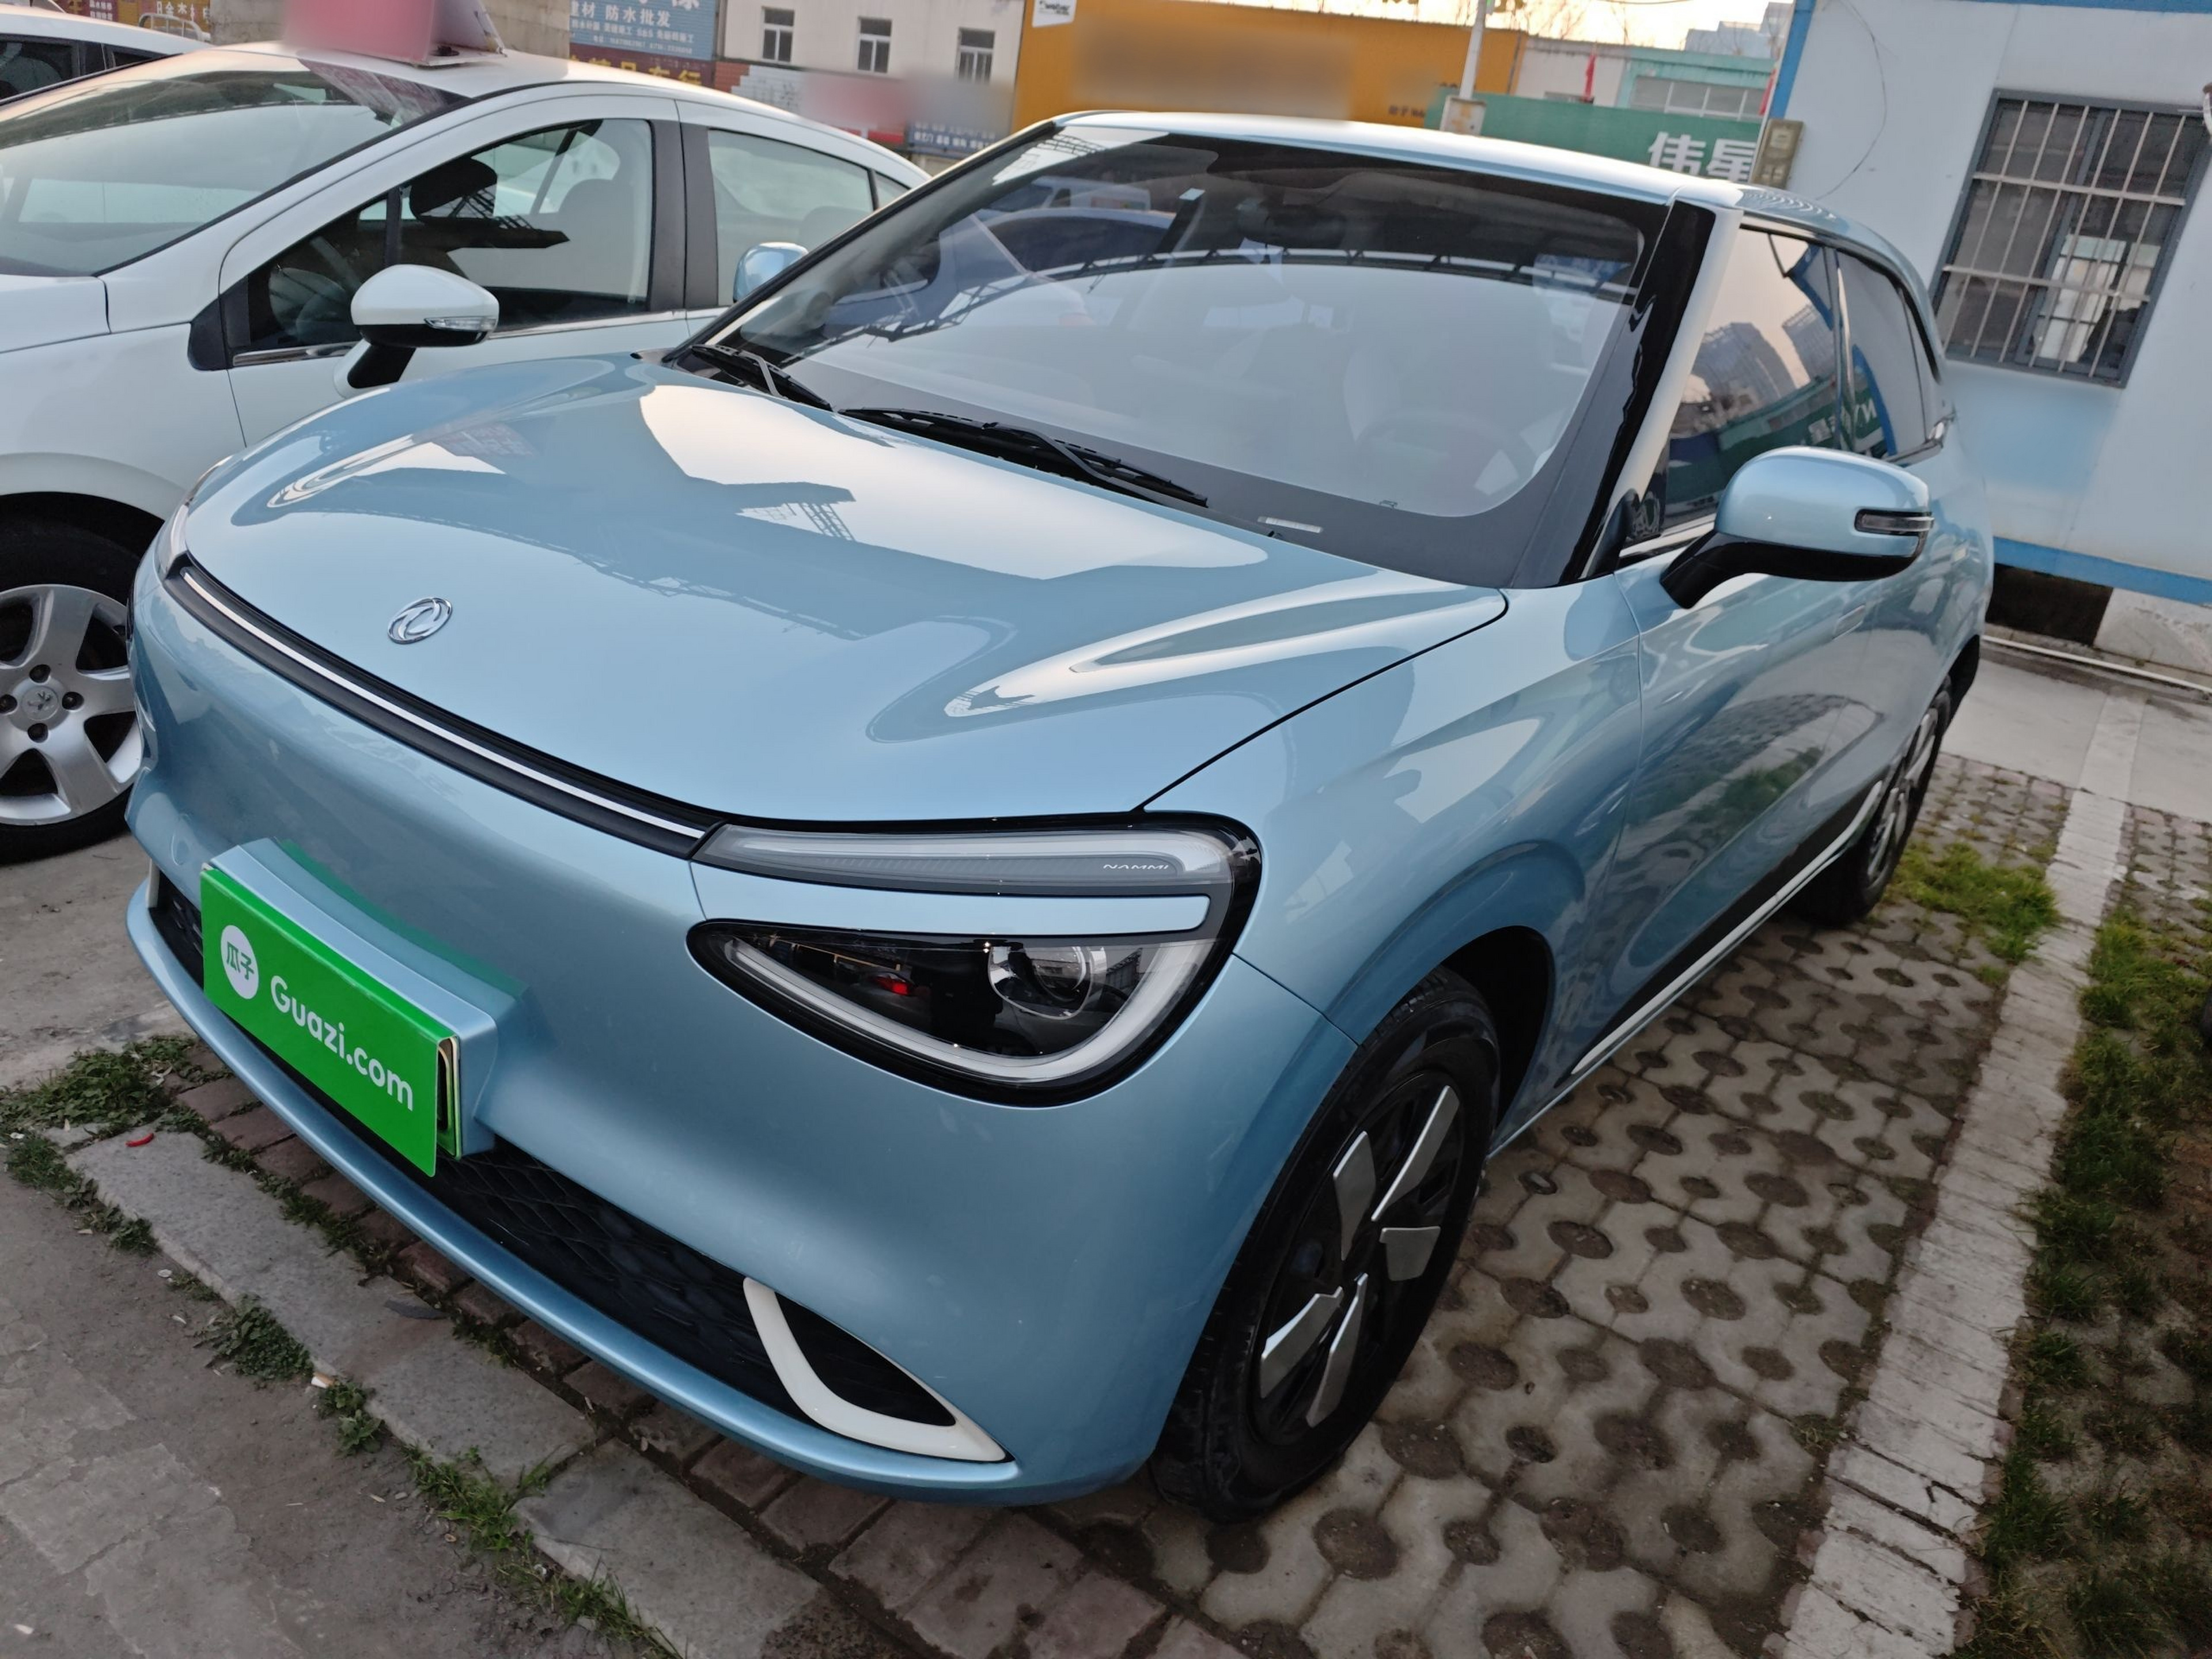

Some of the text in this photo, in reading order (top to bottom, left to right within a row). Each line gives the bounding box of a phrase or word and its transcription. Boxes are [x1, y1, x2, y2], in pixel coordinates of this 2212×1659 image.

[605, 5, 671, 28] 防水批发
[1648, 131, 1756, 183] 伟星
[226, 941, 414, 1112] 瓜子 Guazi.com
